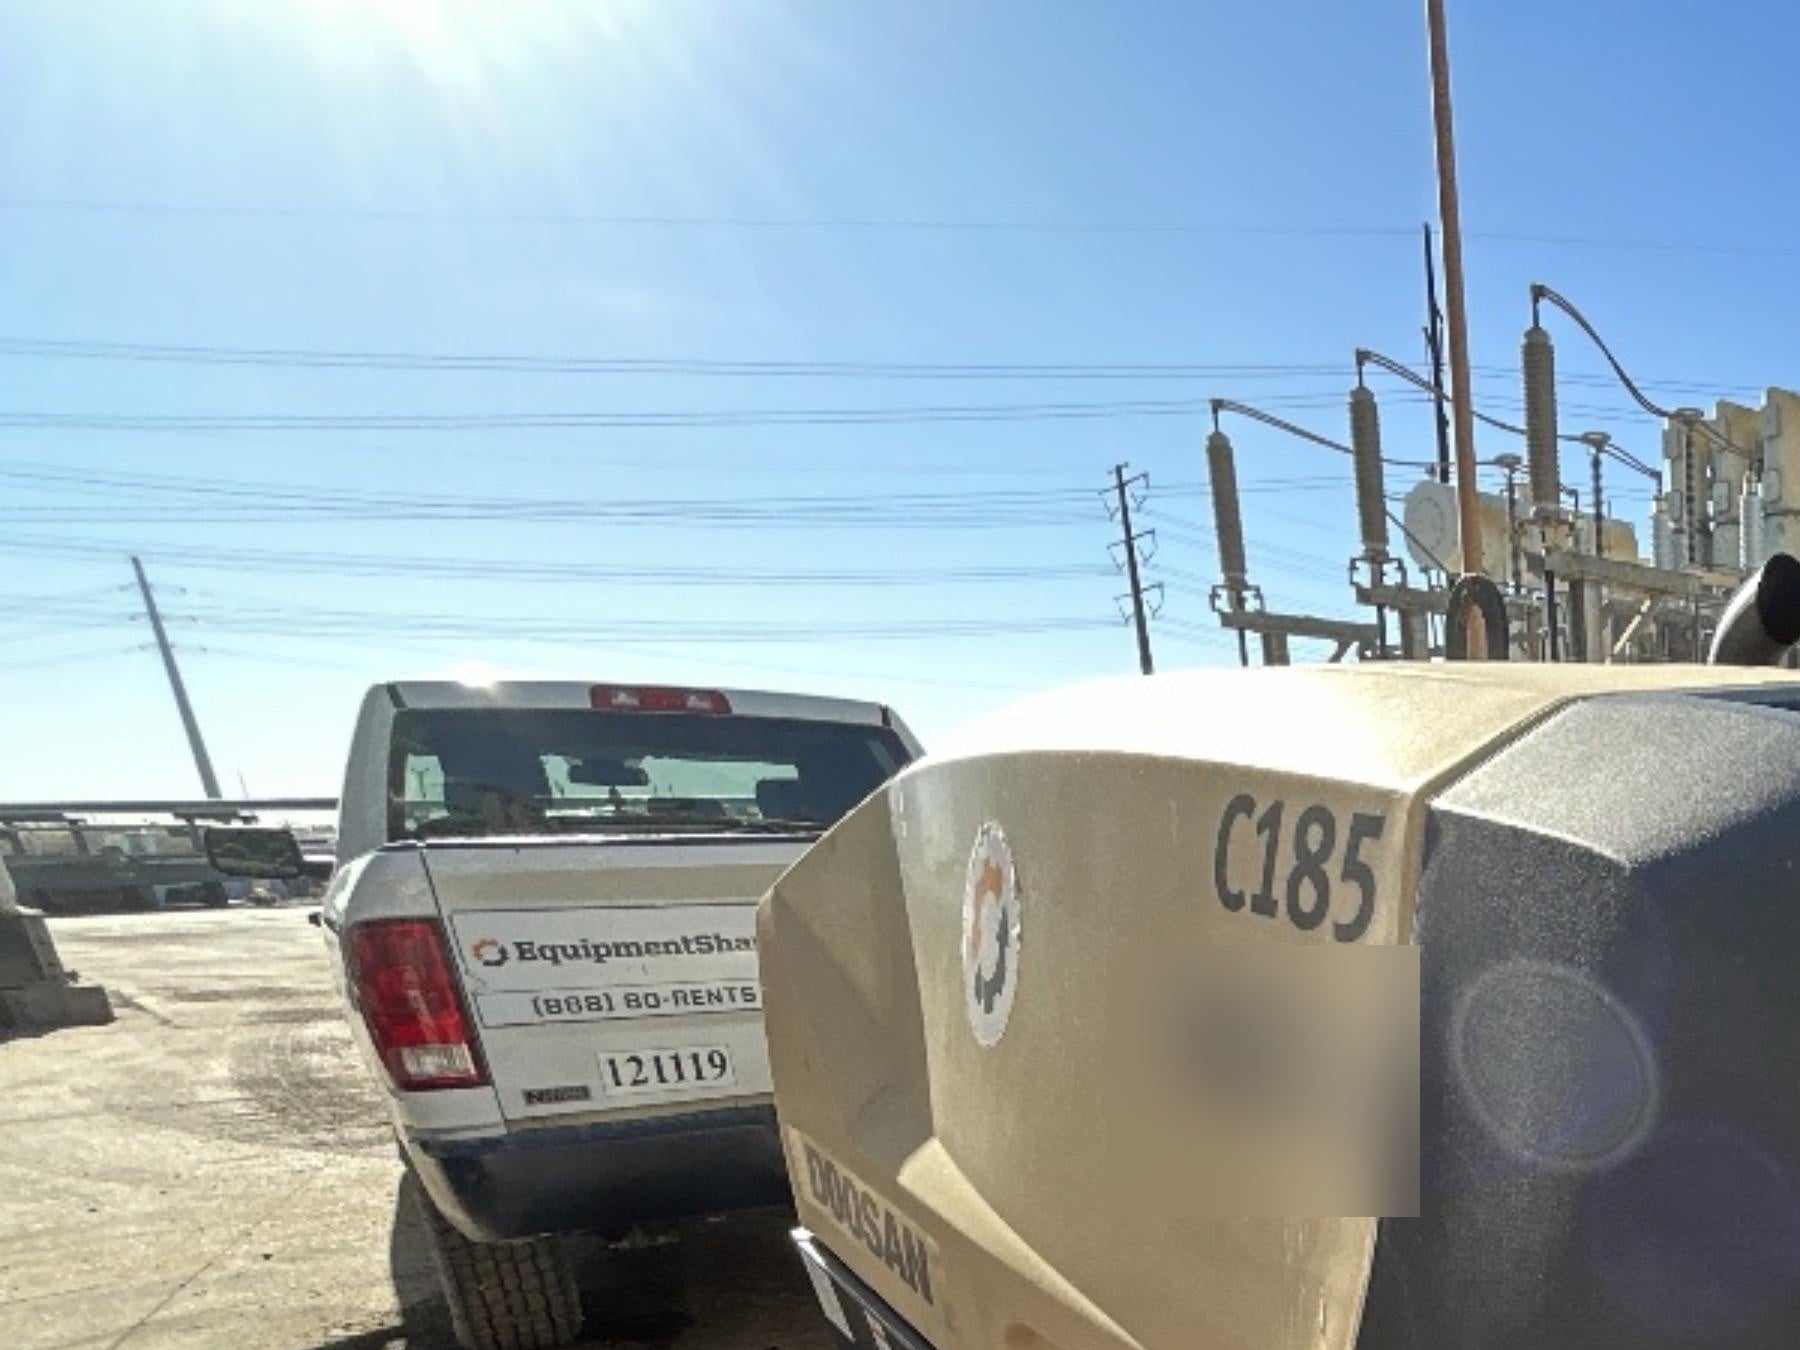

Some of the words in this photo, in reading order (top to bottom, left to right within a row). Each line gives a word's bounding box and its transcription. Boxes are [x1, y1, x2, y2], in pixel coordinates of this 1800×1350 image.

[1213, 793, 1386, 943] C185
[606, 1049, 728, 1087] 121119
[804, 1143, 934, 1306] DOOSAN
